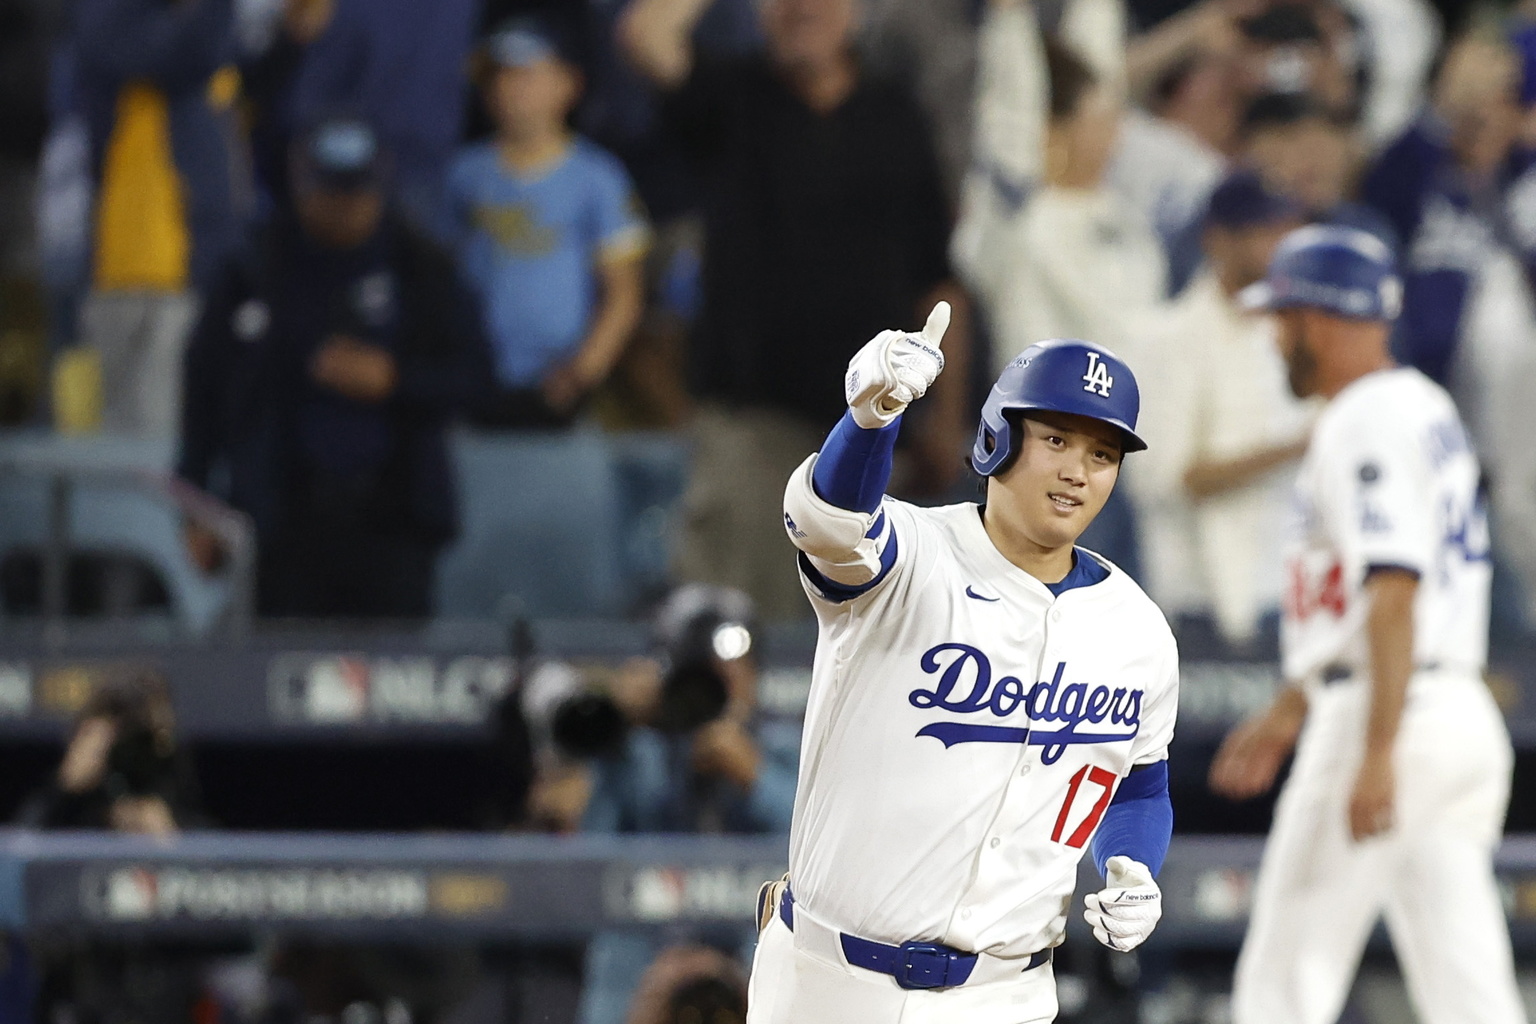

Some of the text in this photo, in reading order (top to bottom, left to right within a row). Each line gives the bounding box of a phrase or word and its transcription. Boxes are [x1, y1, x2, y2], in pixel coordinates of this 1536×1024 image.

[905, 338, 922, 348] new
[1083, 351, 1114, 398] LA
[908, 642, 1144, 766] Dodgers
[1050, 763, 1118, 849] 17
